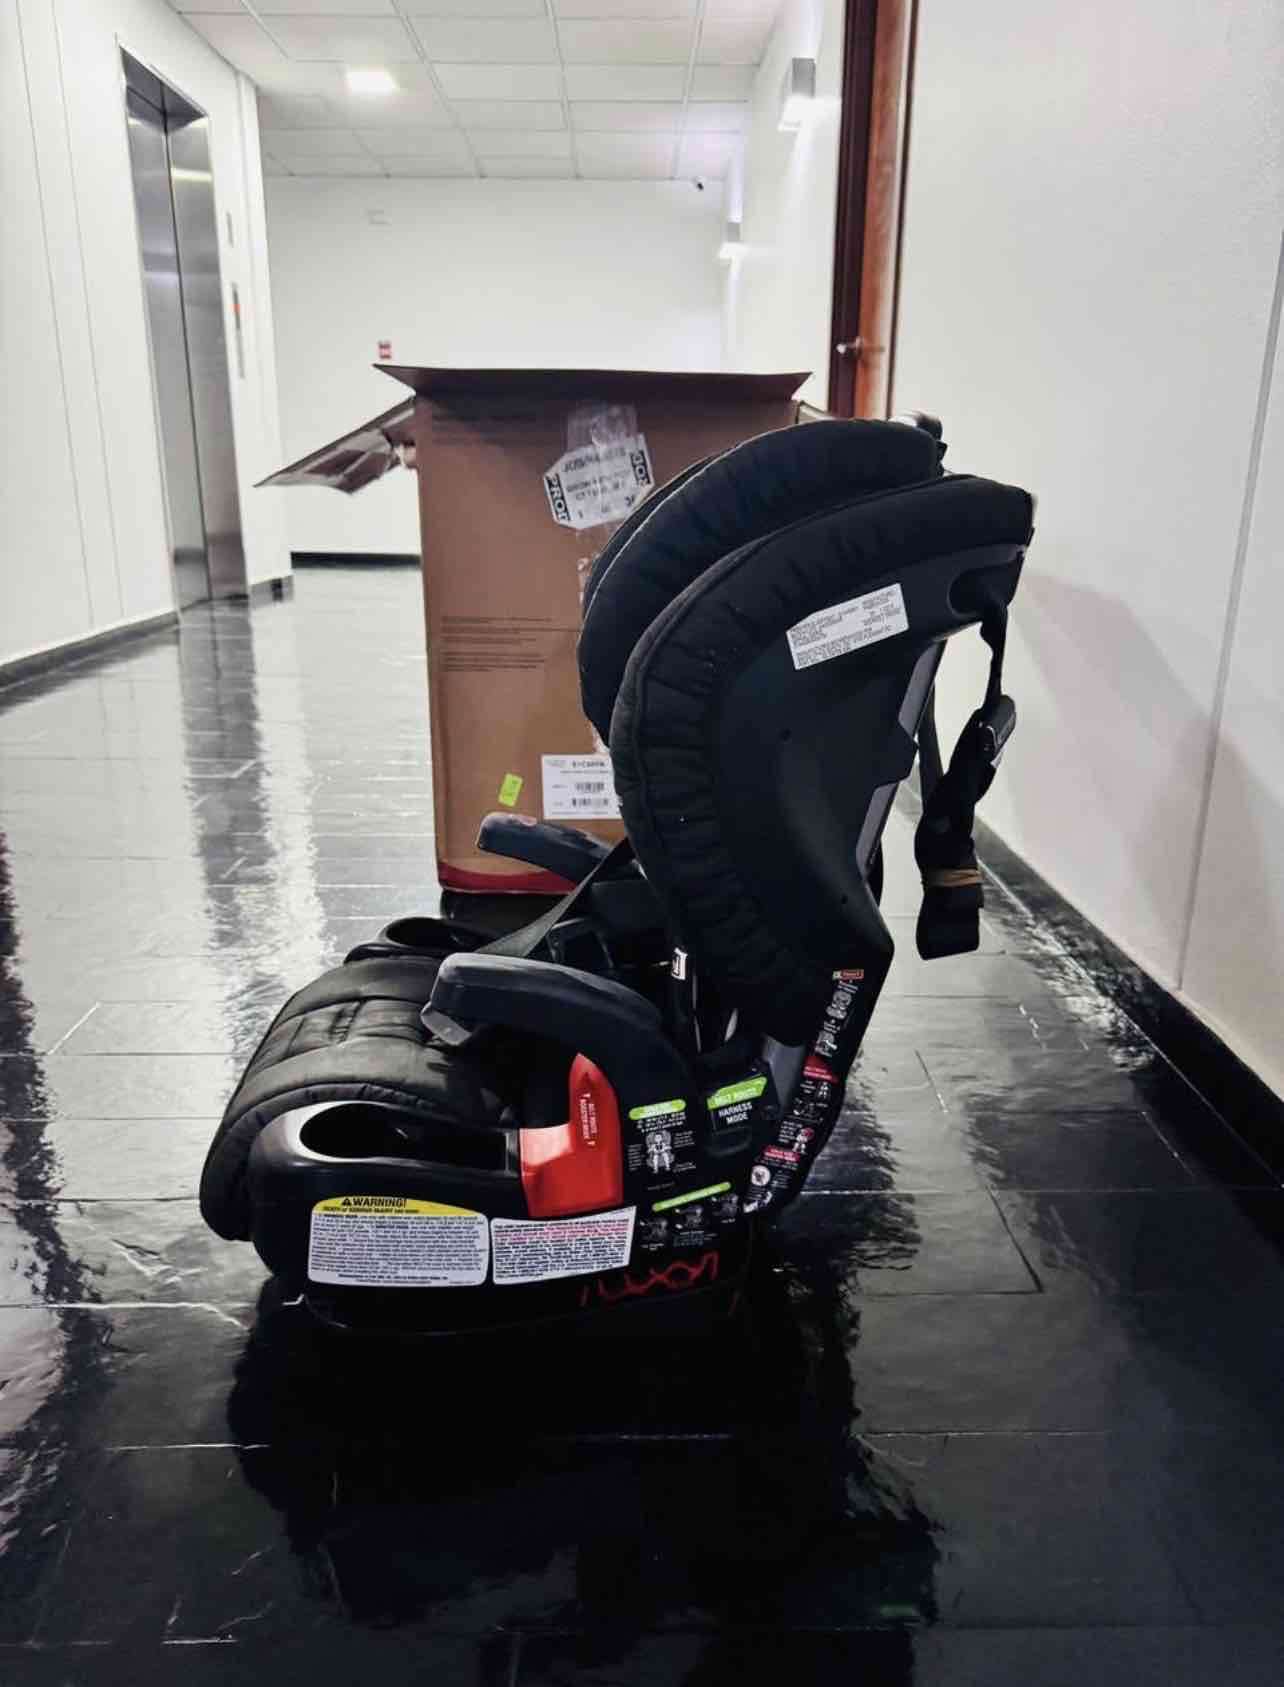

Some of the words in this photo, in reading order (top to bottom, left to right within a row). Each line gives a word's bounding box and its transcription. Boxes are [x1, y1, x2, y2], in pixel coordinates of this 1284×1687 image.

[718, 1102, 753, 1118] HARNESS
[726, 1112, 749, 1125] MODE
[352, 1198, 407, 1208] WARNING!
